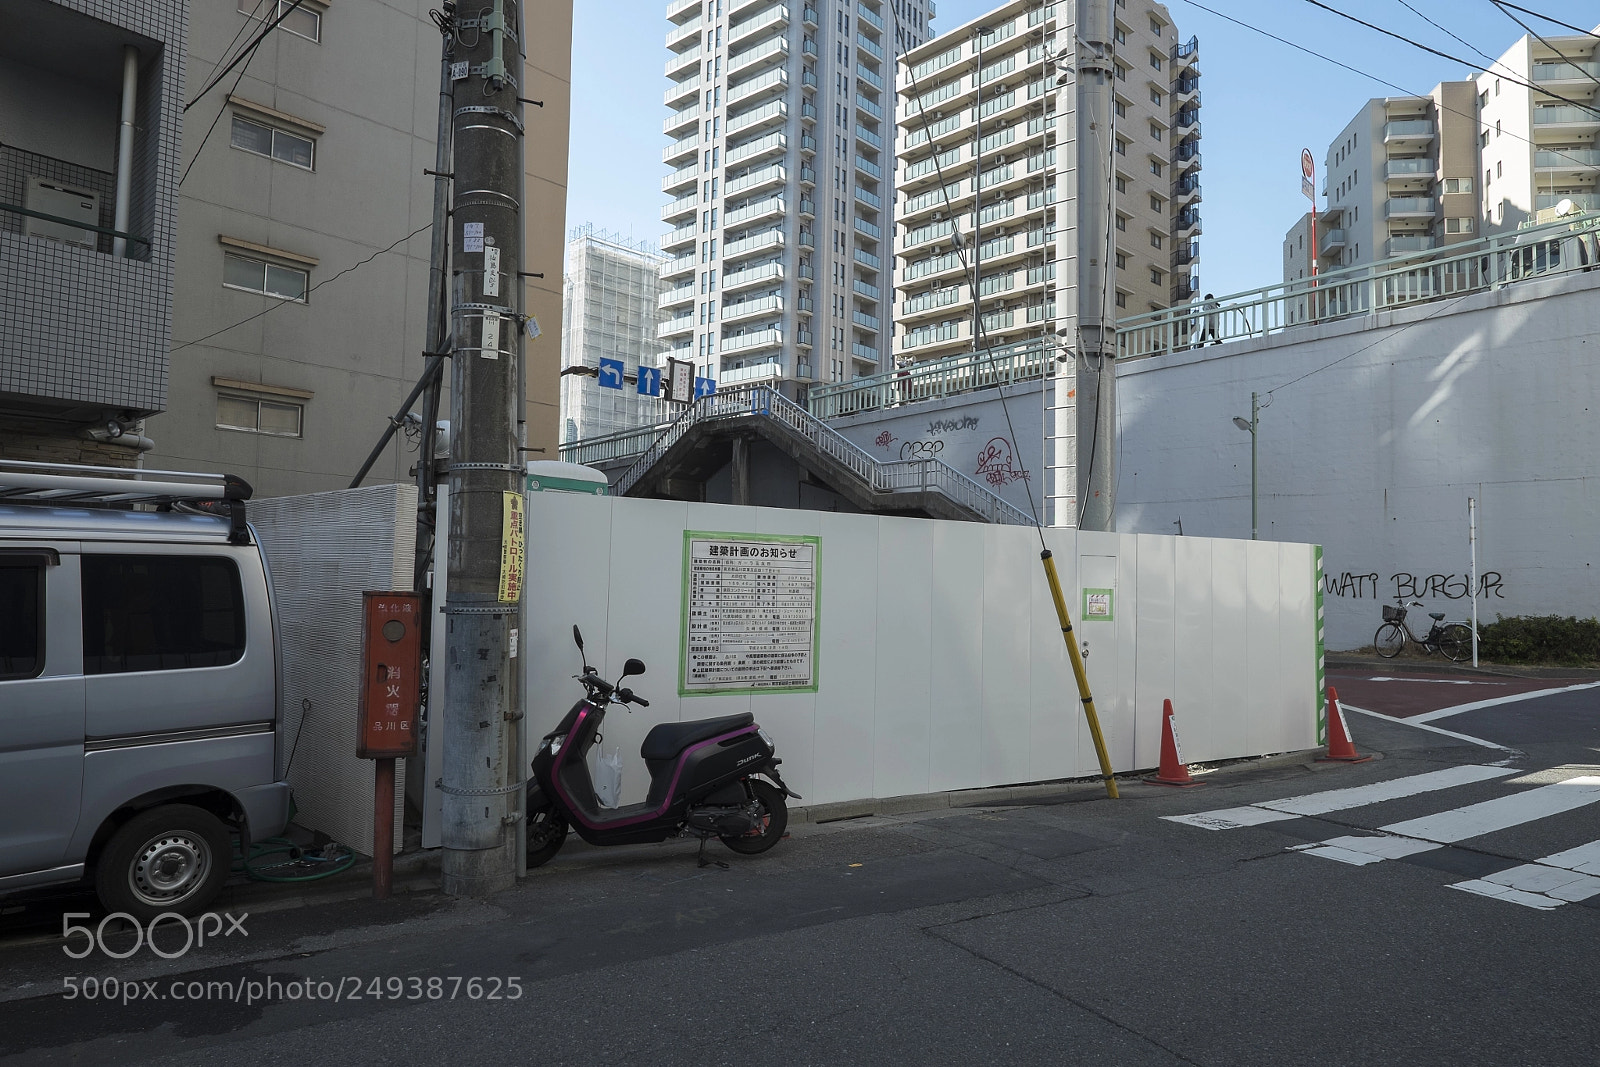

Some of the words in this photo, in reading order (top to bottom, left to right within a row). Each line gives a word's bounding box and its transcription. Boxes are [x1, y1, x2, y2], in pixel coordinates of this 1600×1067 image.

[507, 511, 519, 600] 重点パトロール実施中
[709, 545, 797, 559] 建築計画のお知らせ
[373, 721, 410, 731] 品川区
